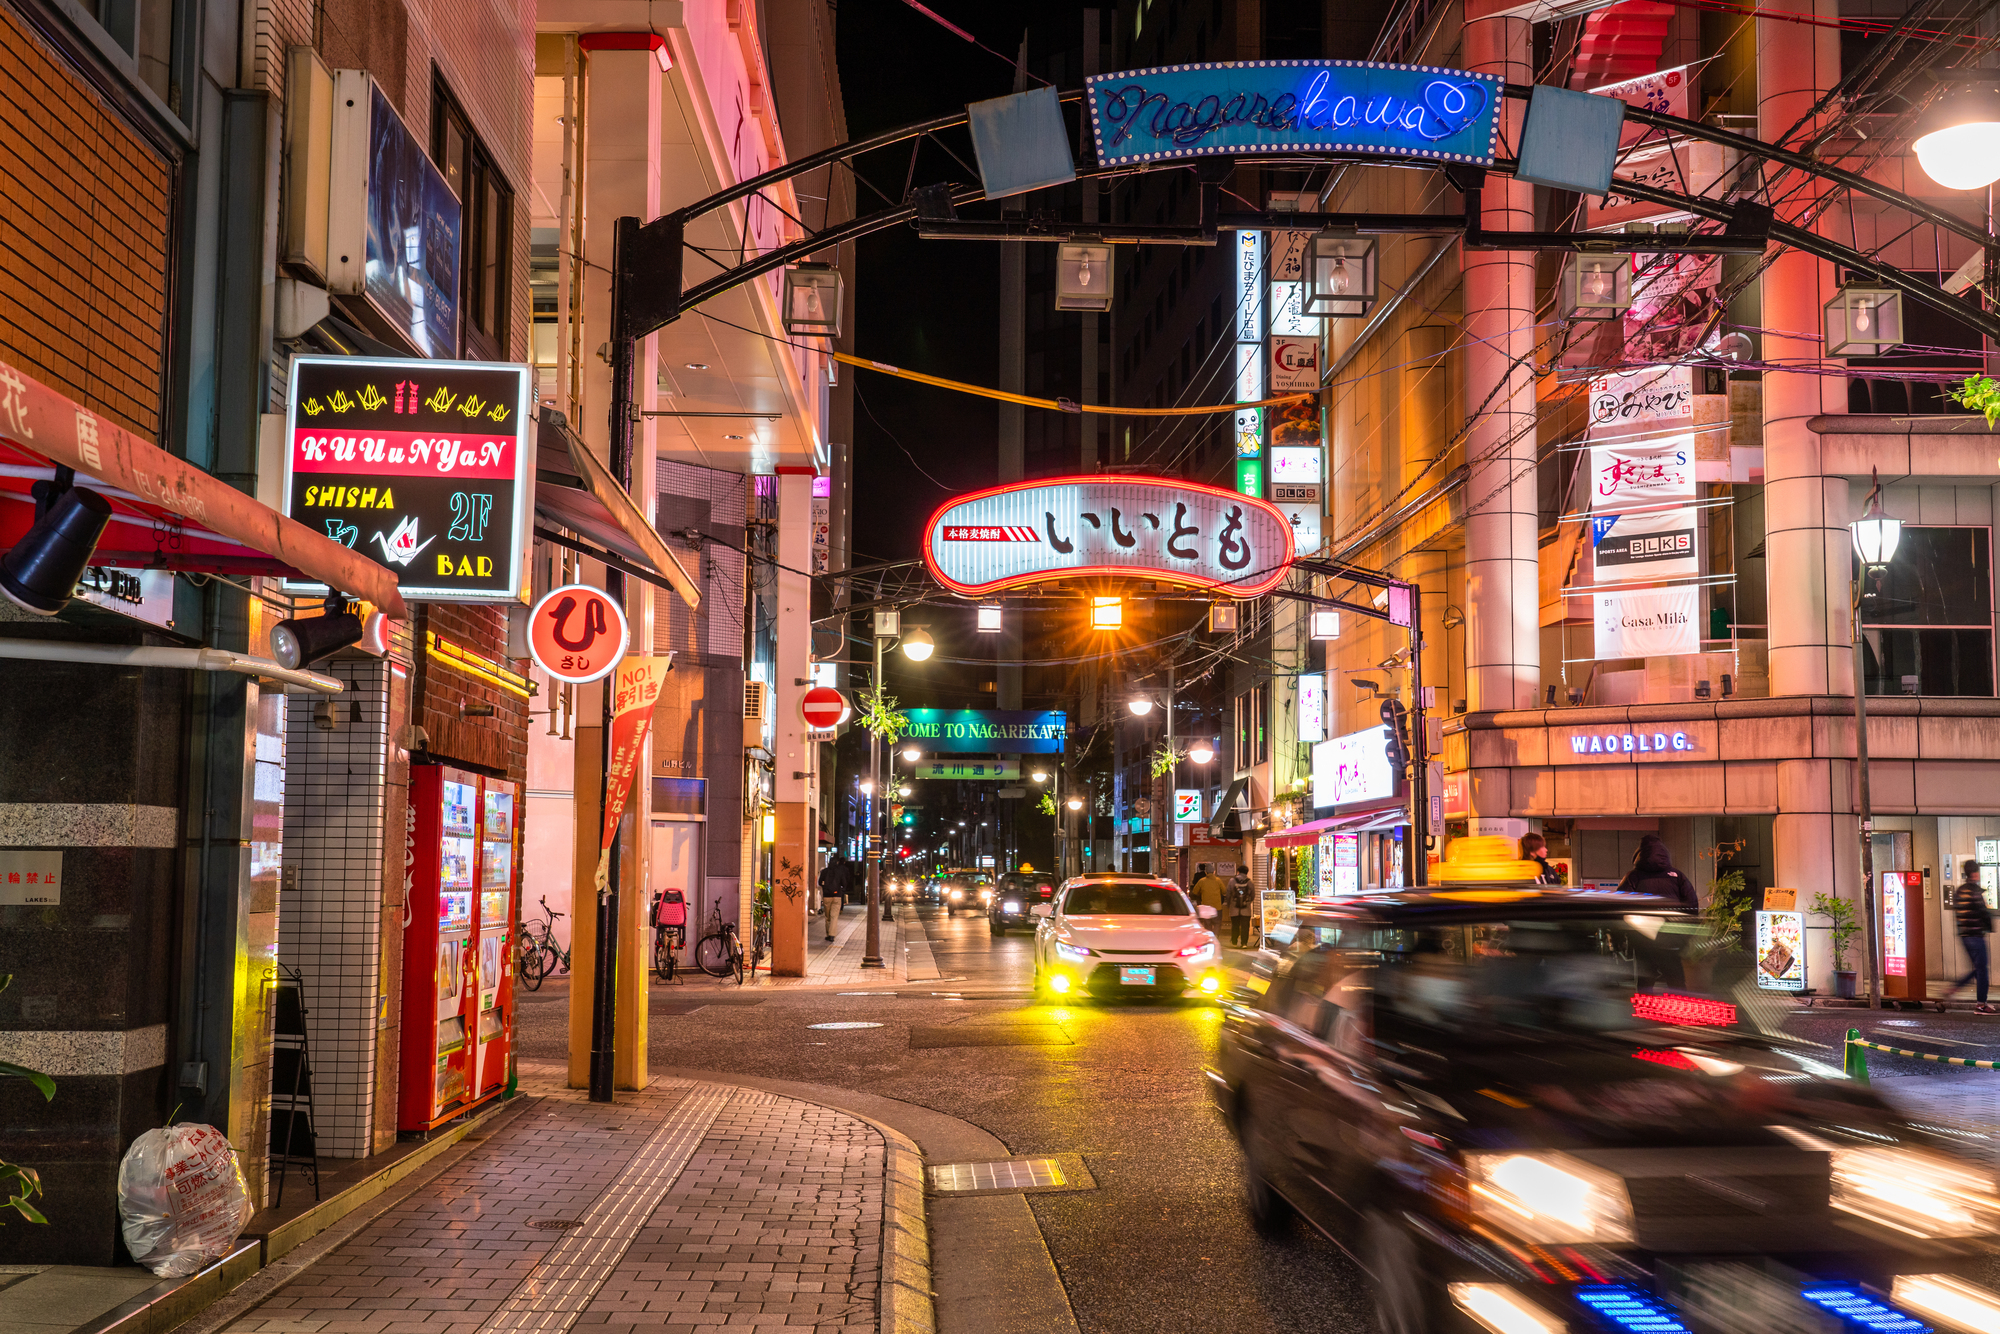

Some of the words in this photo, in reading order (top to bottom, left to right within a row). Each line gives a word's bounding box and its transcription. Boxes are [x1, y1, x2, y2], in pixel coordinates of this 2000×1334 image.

[1275, 338, 1286, 346] 3F
[1590, 380, 1607, 391] 2F
[1675, 450, 1687, 466] S
[304, 485, 395, 509] SHISHA
[1276, 489, 1315, 498] BLKS
[447, 491, 493, 542] 2F
[1594, 518, 1612, 532] 1F
[947, 528, 1001, 541] 本格麦焼酎
[1045, 501, 1252, 571] いいとも
[1631, 536, 1689, 553] BLKS
[437, 554, 493, 577] BAR
[1604, 599, 1613, 607] B1
[548, 596, 607, 653] ひ
[560, 655, 590, 670] さし
[622, 665, 652, 688] NO!
[616, 682, 659, 712] 客引き
[944, 723, 965, 738] TO
[663, 759, 692, 769] 山野ビル
[932, 762, 1005, 776] 流川通り
[0, 871, 57, 884] 輪禁止
